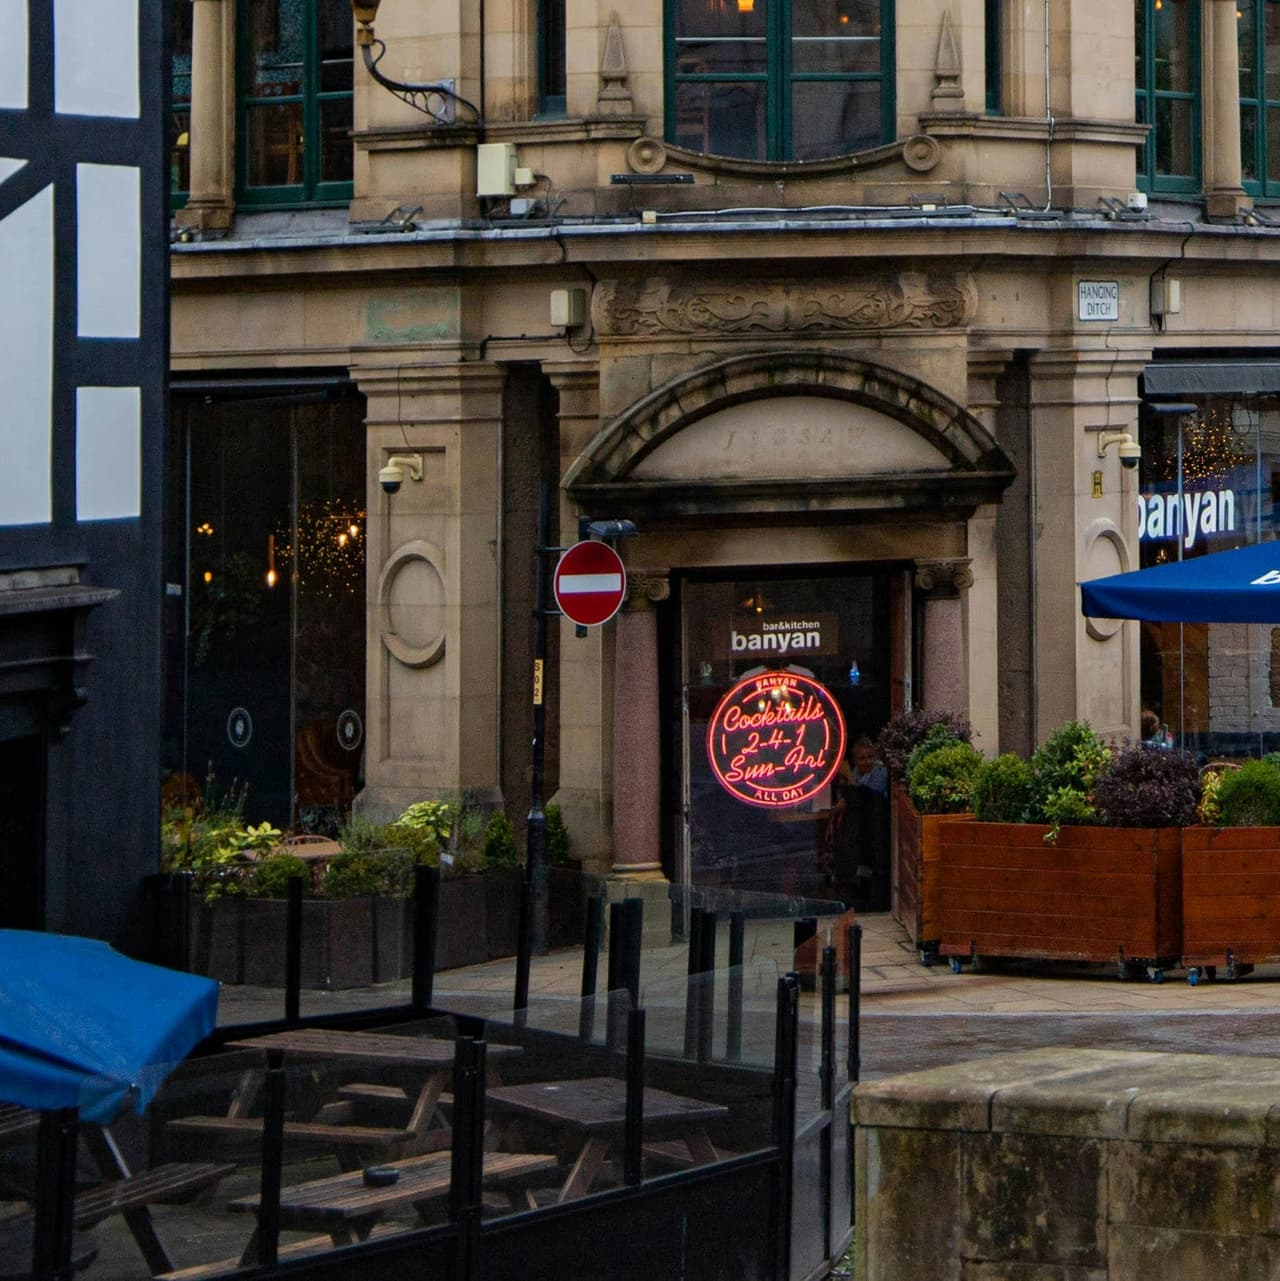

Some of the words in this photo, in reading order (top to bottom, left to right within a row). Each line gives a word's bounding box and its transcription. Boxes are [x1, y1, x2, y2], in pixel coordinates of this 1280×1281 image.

[1080, 286, 1117, 299] HANGING
[1087, 302, 1111, 316] DITCH
[763, 620, 820, 631] bar&kitchen
[731, 631, 820, 653] banyan
[755, 678, 798, 689] BANYAN
[723, 694, 825, 732] Cocktails
[741, 723, 806, 755] 2-4-1
[754, 788, 778, 802] ALL
[782, 787, 805, 801] DAY
